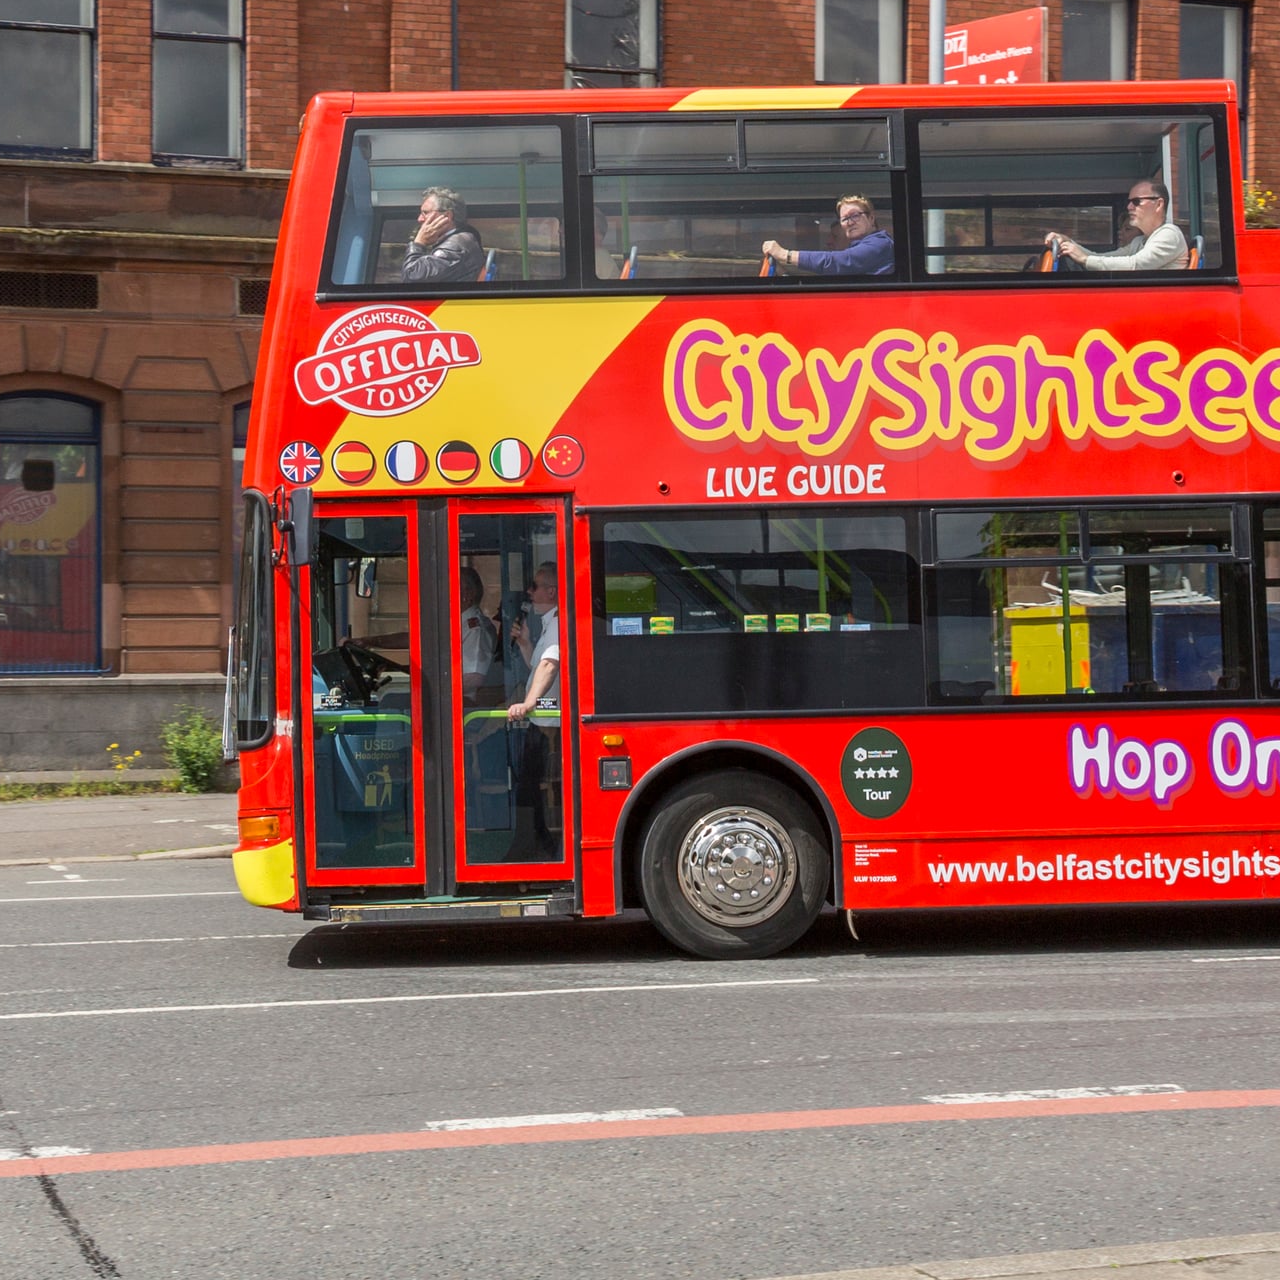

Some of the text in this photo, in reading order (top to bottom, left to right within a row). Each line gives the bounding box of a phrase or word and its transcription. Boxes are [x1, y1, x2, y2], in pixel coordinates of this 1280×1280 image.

[944, 35, 967, 54] DTZ
[1007, 46, 1033, 58] Pierce
[332, 311, 427, 347] CITYSIGHTSEEING
[314, 335, 470, 393] OFFICIAL
[365, 375, 434, 407] TOUR
[706, 463, 886, 498] LIVE GUIDE
[364, 740, 394, 751] USED
[1069, 724, 1192, 802] Hop
[863, 788, 892, 801] Tour
